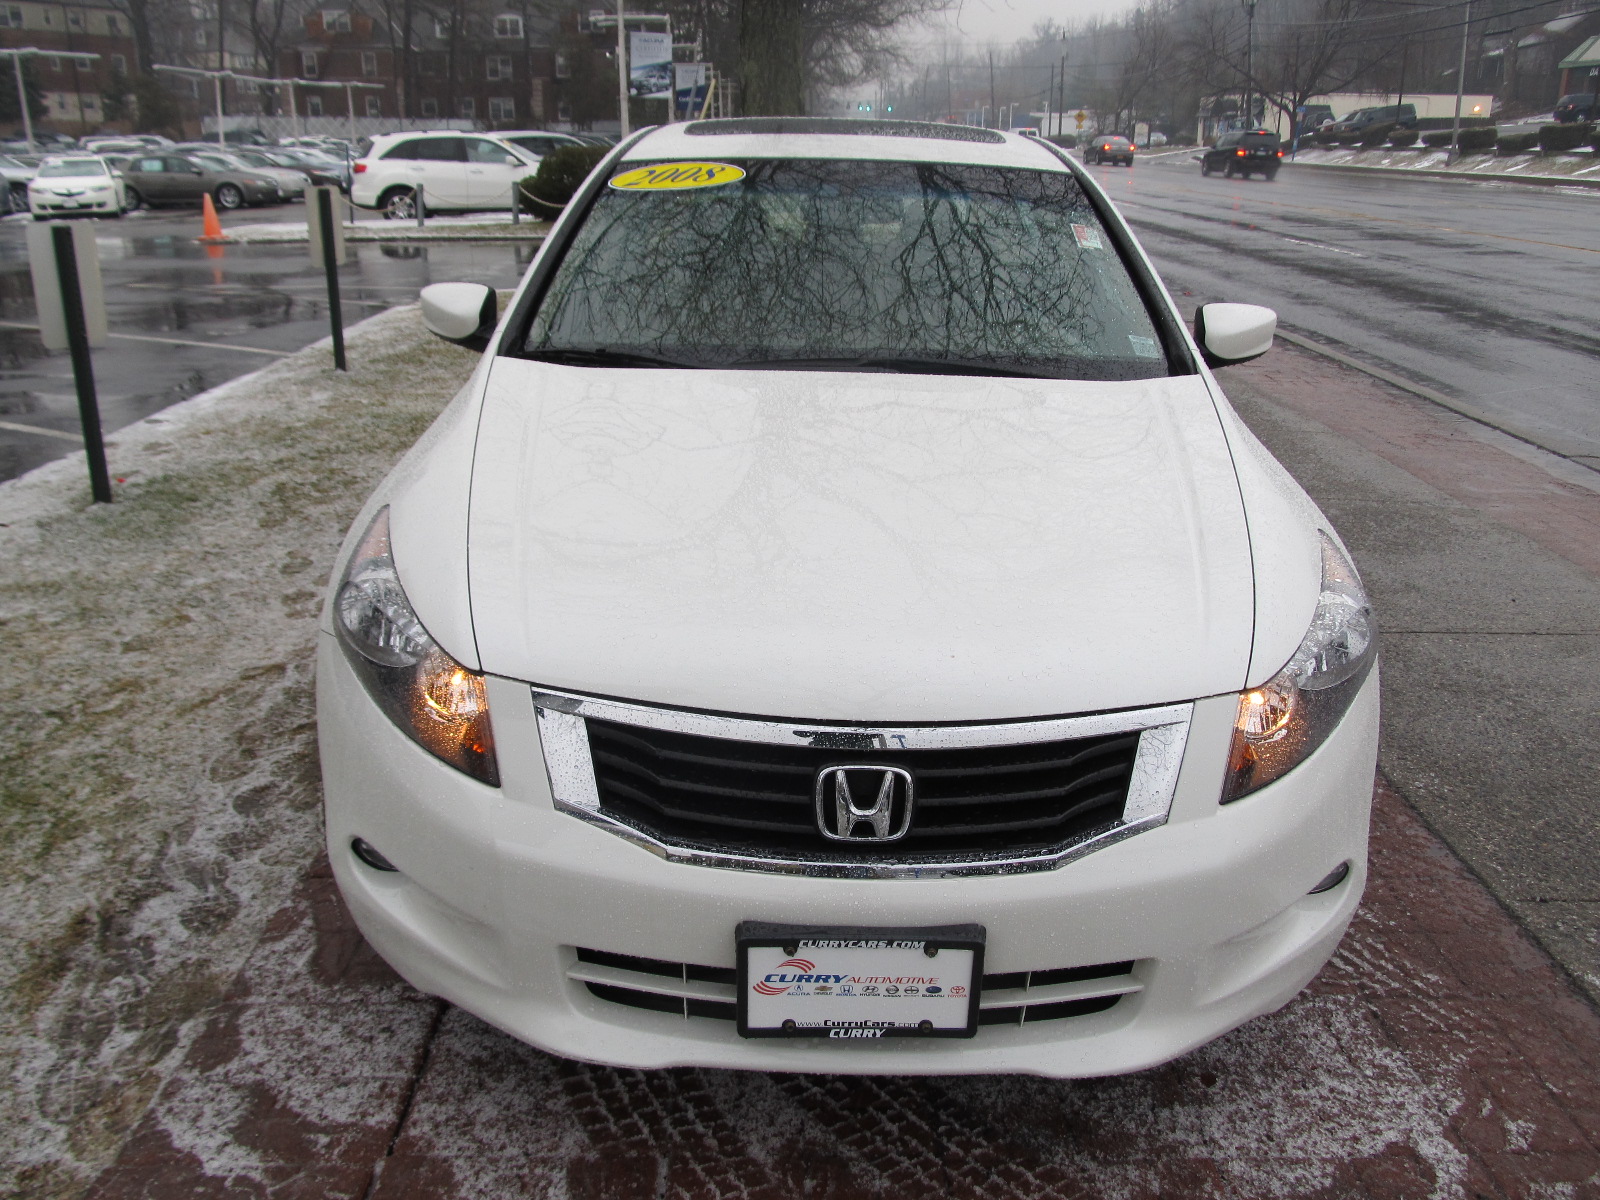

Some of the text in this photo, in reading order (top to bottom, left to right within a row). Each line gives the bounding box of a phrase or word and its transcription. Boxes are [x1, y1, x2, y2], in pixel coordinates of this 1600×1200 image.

[621, 166, 726, 187] 2008
[798, 940, 926, 950] CURRYCARS.COM
[763, 973, 940, 985] CURRY AUTOMOTIVE
[796, 1019, 920, 1028] www.CurryCars.com
[829, 1028, 887, 1038] CURRY
